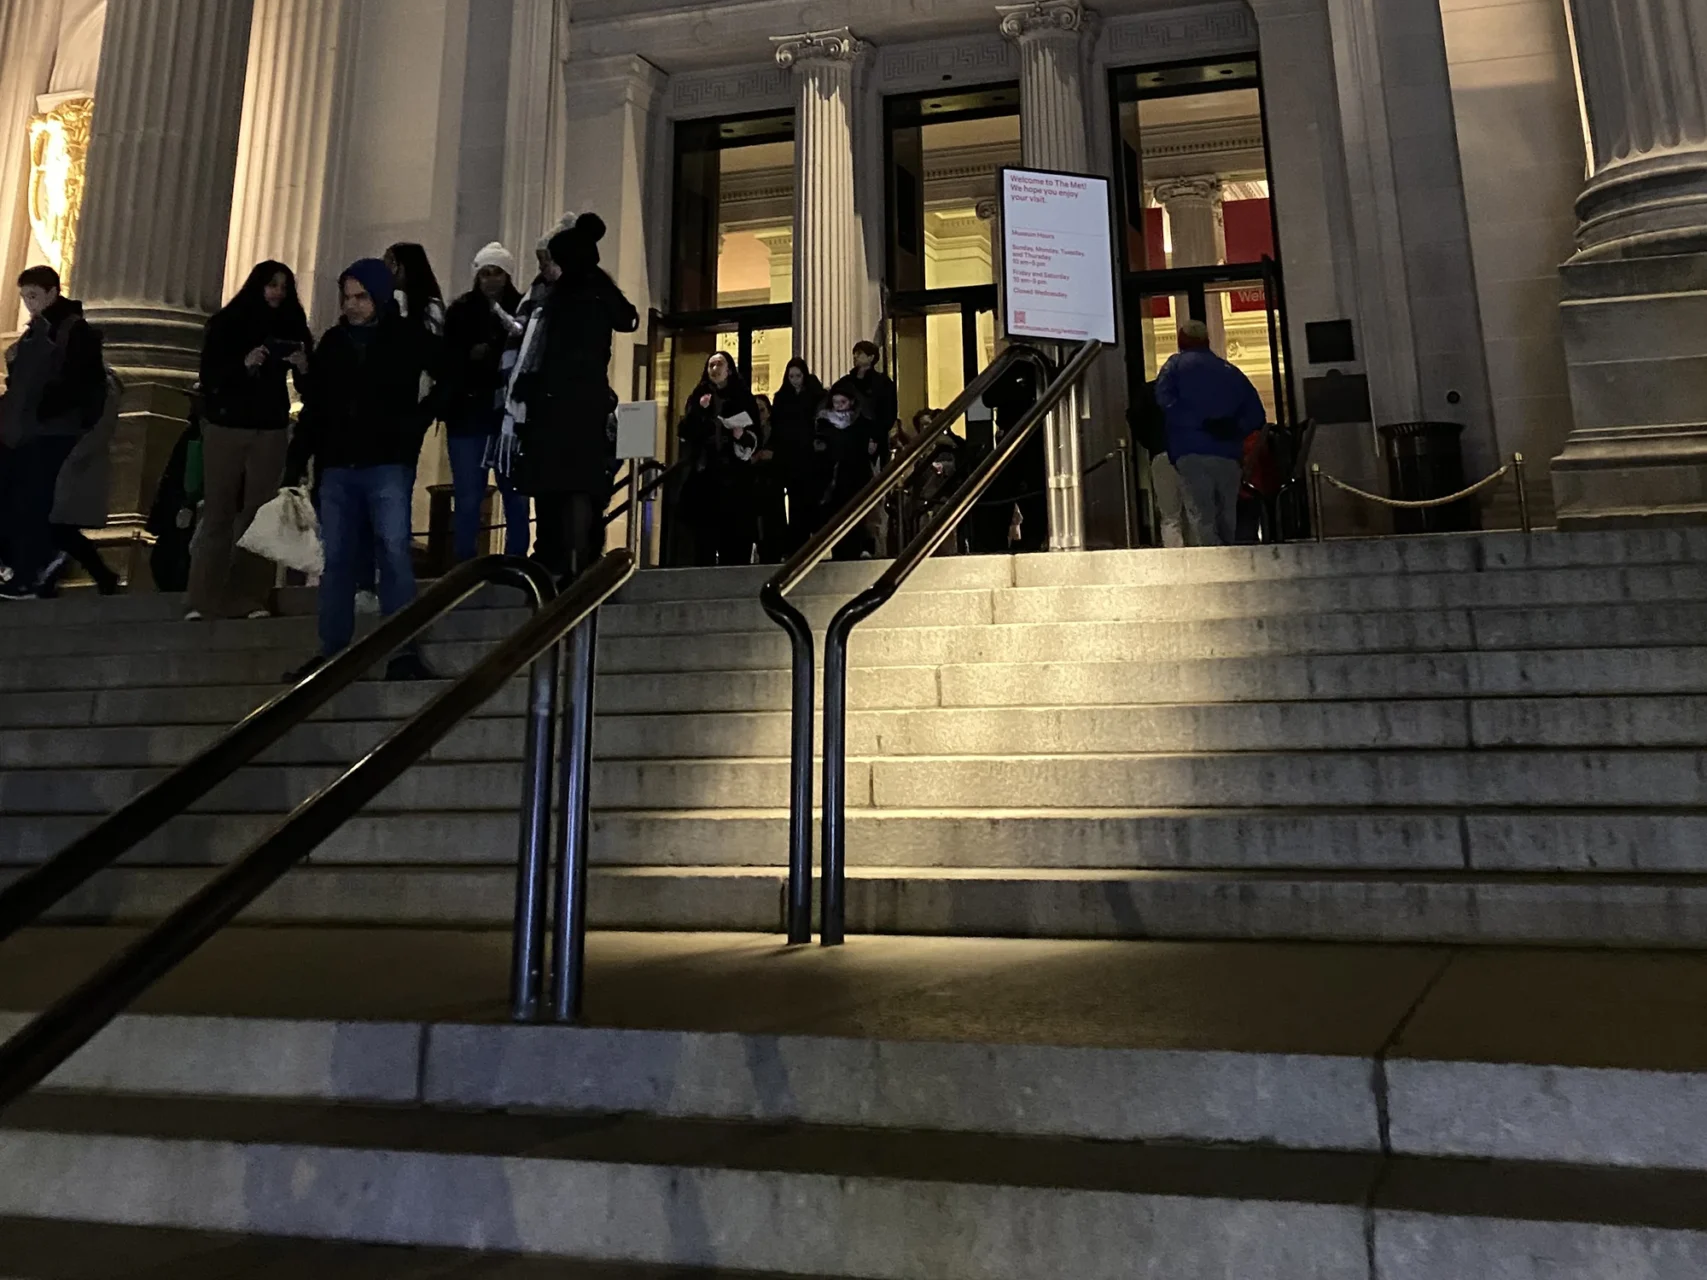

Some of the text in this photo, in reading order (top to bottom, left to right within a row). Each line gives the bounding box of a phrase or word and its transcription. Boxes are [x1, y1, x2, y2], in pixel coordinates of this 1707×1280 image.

[1010, 175, 1044, 185] Welcome
[1055, 179, 1069, 188] The
[1010, 184, 1079, 199] We hope you enjoy
[1011, 194, 1028, 202] your
